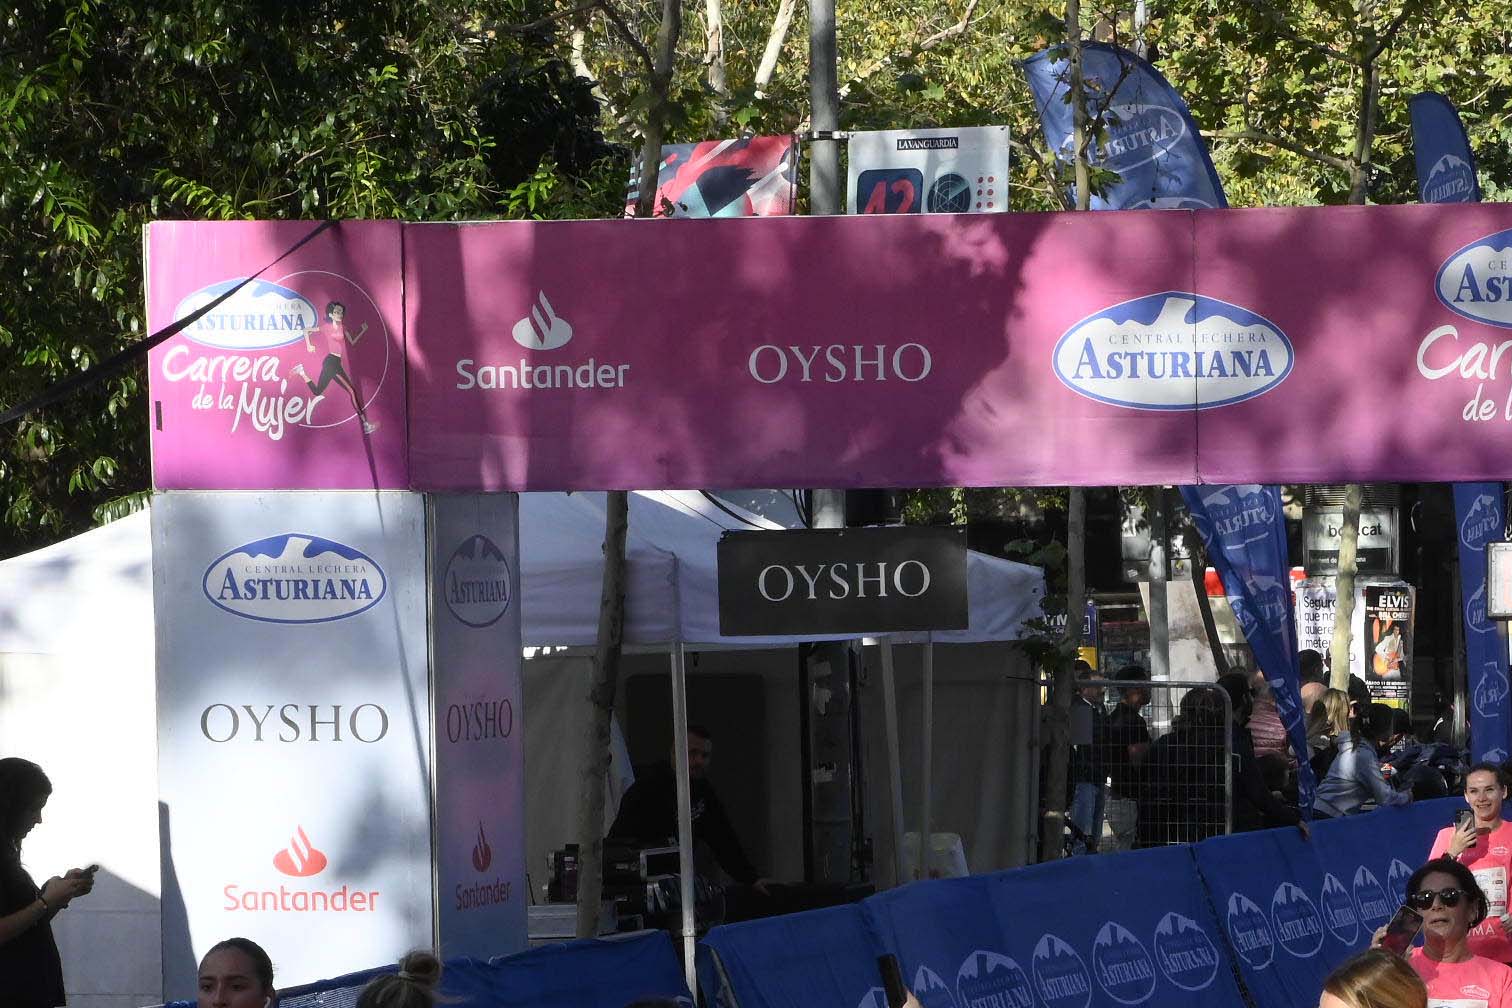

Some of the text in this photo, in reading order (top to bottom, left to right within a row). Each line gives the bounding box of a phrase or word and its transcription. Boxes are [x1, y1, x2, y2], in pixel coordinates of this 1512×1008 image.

[1108, 331, 1268, 345] CENTRAL LECHERA
[161, 344, 280, 383] Carrera
[456, 357, 630, 390] Santander
[748, 343, 933, 384] OYSHO
[1072, 336, 1275, 380] ASTURIANA
[191, 379, 326, 441] de la Mujer
[1462, 387, 1498, 421] de
[217, 567, 373, 601] ASTURIANA
[245, 564, 368, 574] CENTRAL LECHERA
[757, 559, 931, 602] OYSHO
[1379, 595, 1409, 608] ELVIS
[200, 702, 389, 744] OYSHO
[447, 698, 513, 744] OYSHO
[223, 883, 380, 913] Santander
[455, 876, 512, 911] Santander
